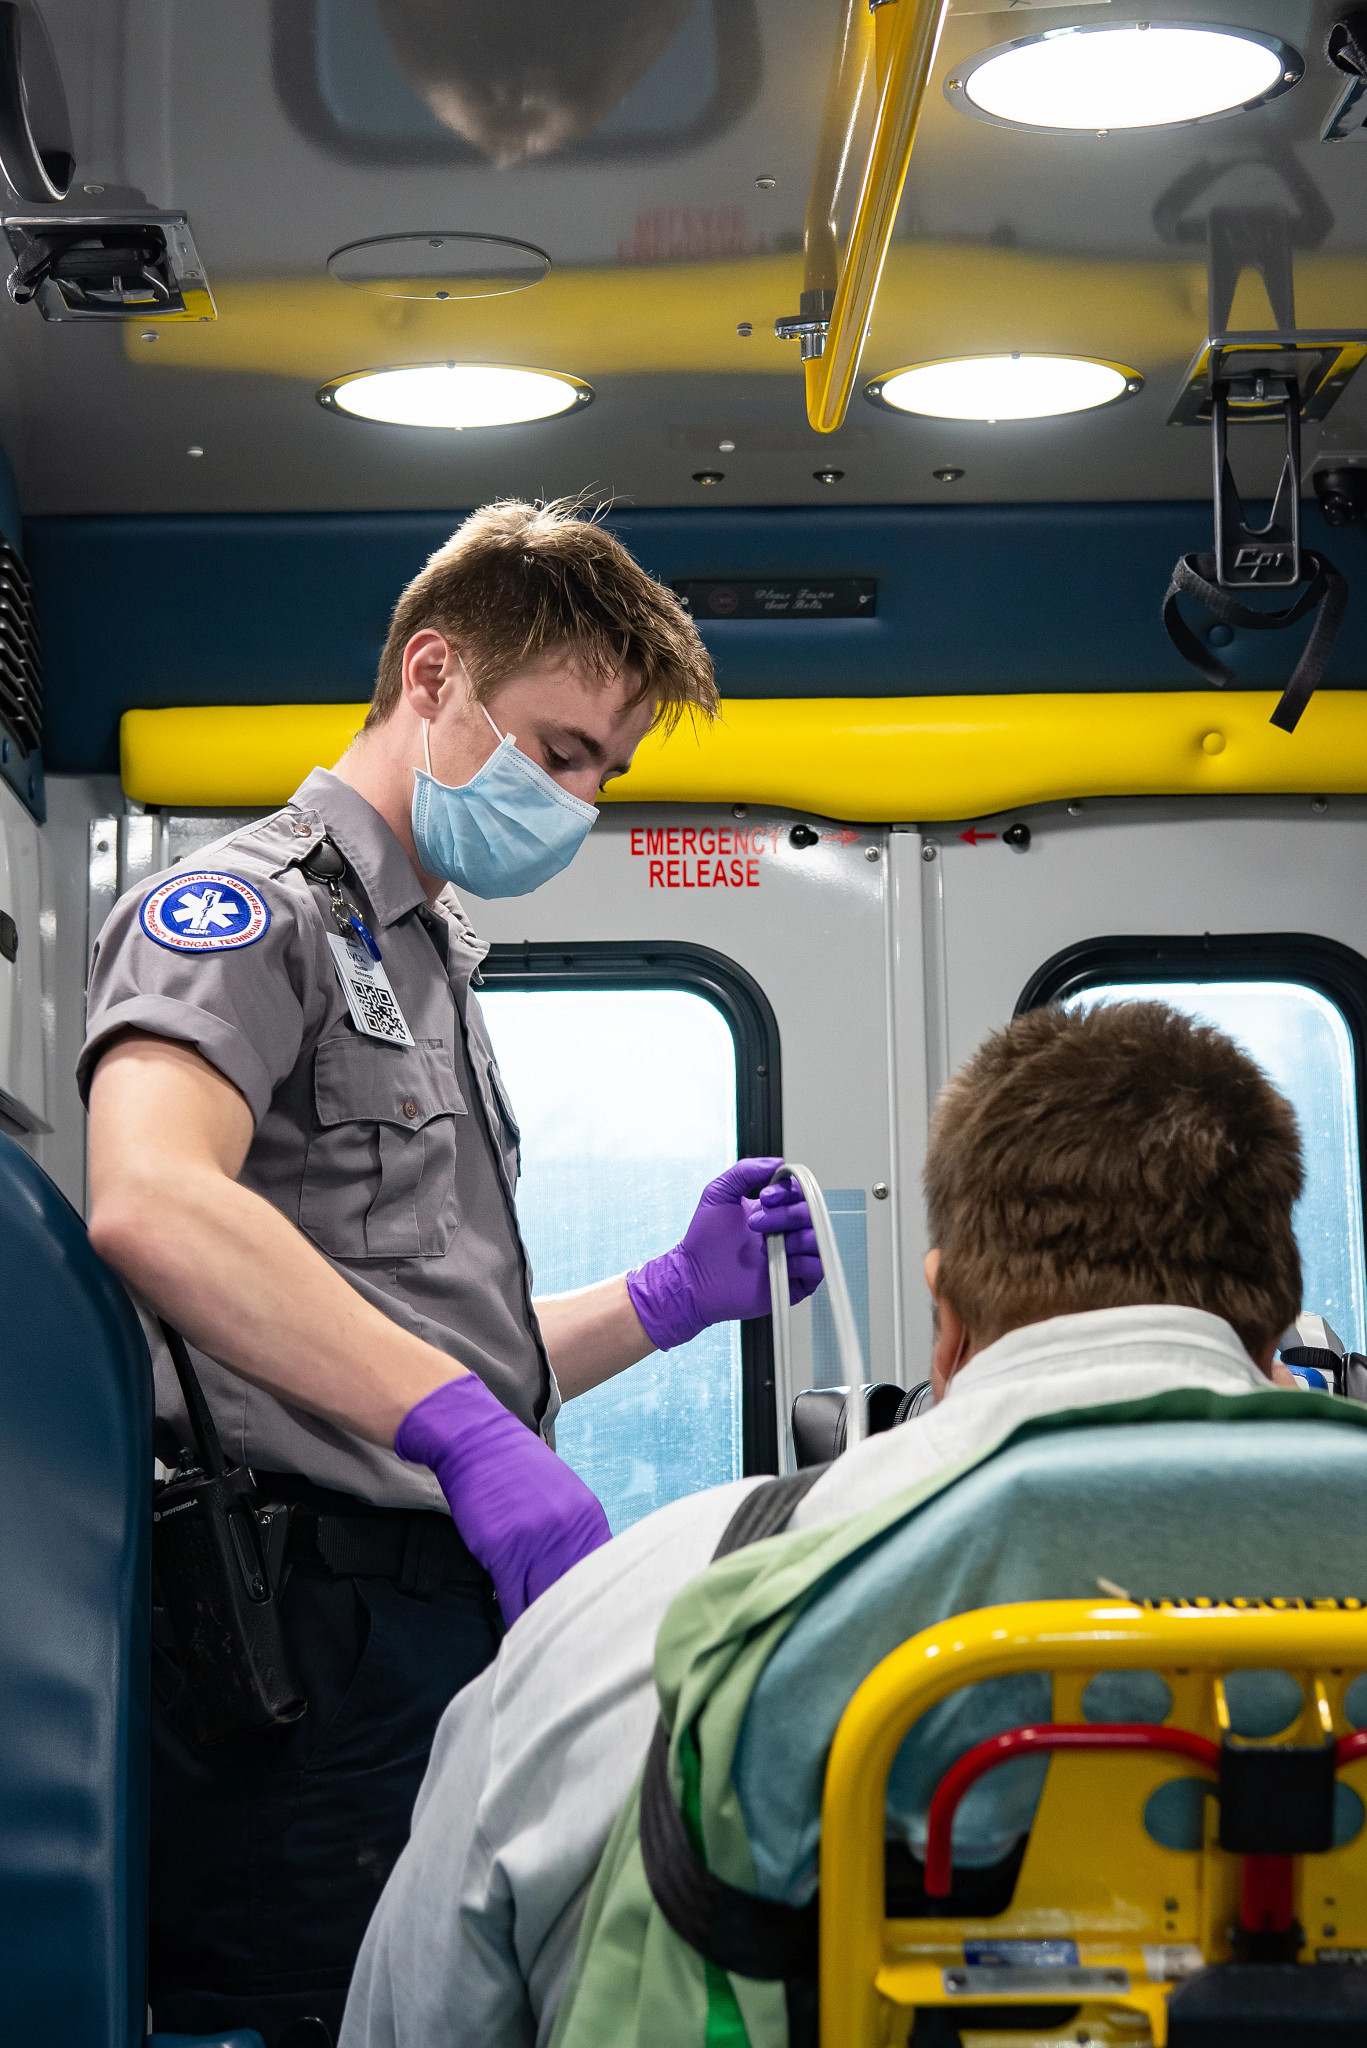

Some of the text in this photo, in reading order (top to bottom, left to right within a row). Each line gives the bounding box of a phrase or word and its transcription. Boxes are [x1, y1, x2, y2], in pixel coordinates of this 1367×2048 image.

[755, 589, 834, 599] Please Fasten
[764, 599, 823, 610] Seat Belts
[631, 827, 782, 855] EMERGENCY
[649, 859, 760, 888] RELEASE
[157, 875, 262, 916] NATIONALLY CERTIFIED
[147, 899, 262, 948] EMERGENCY MEDICAL TECHNICIAN
[162, 1499, 198, 1517] MOTOROLA
